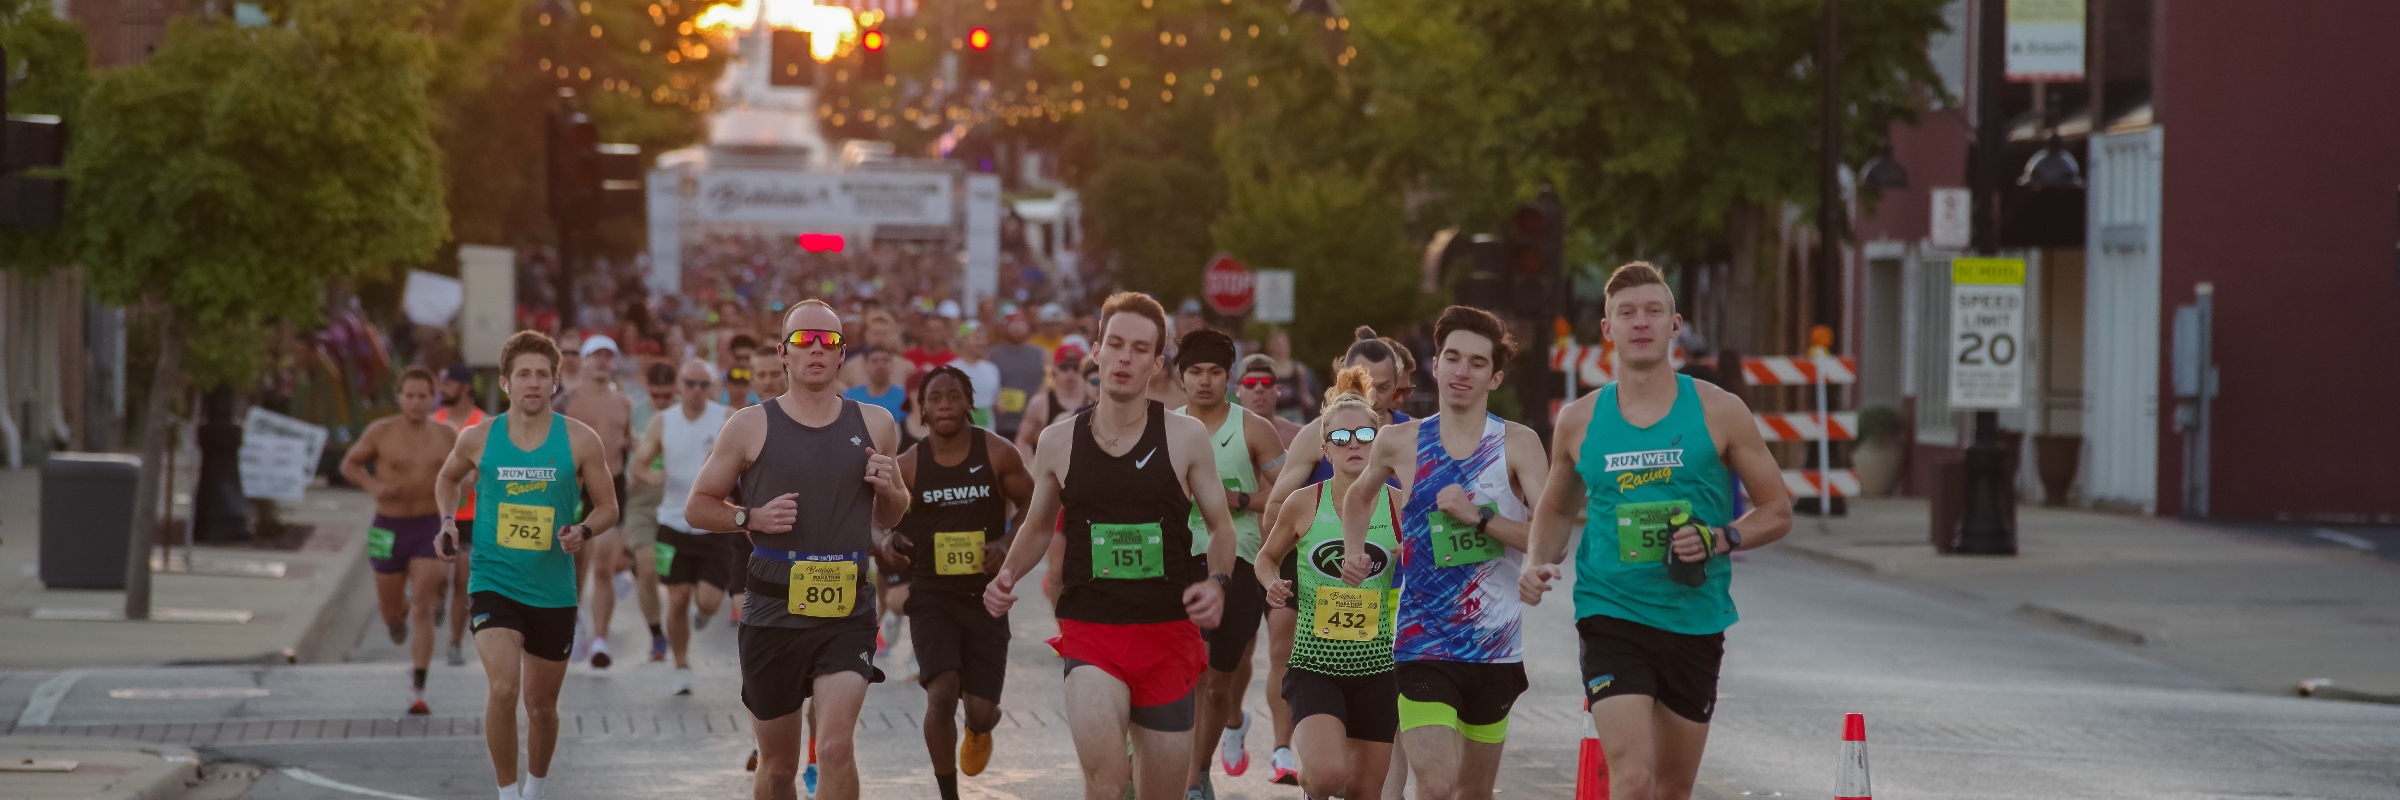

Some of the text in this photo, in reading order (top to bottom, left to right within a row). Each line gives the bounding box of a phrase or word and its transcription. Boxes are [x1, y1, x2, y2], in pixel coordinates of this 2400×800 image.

[1205, 271, 1254, 293] STOP
[1959, 294, 2018, 309] SPEED
[1963, 315, 2010, 327] LIMIT
[1958, 332, 2016, 365] 20
[1610, 452, 1677, 468] RUN WELL
[502, 468, 552, 478] RUN WELL
[1616, 466, 1673, 493] Racing
[506, 480, 548, 497] Racing
[922, 485, 990, 503] SPEWAK
[509, 524, 541, 540] 762
[1449, 531, 1488, 552] 165
[947, 551, 975, 565] 819
[1111, 549, 1143, 567] 151
[805, 586, 843, 604] 801
[1328, 611, 1366, 629] 432
